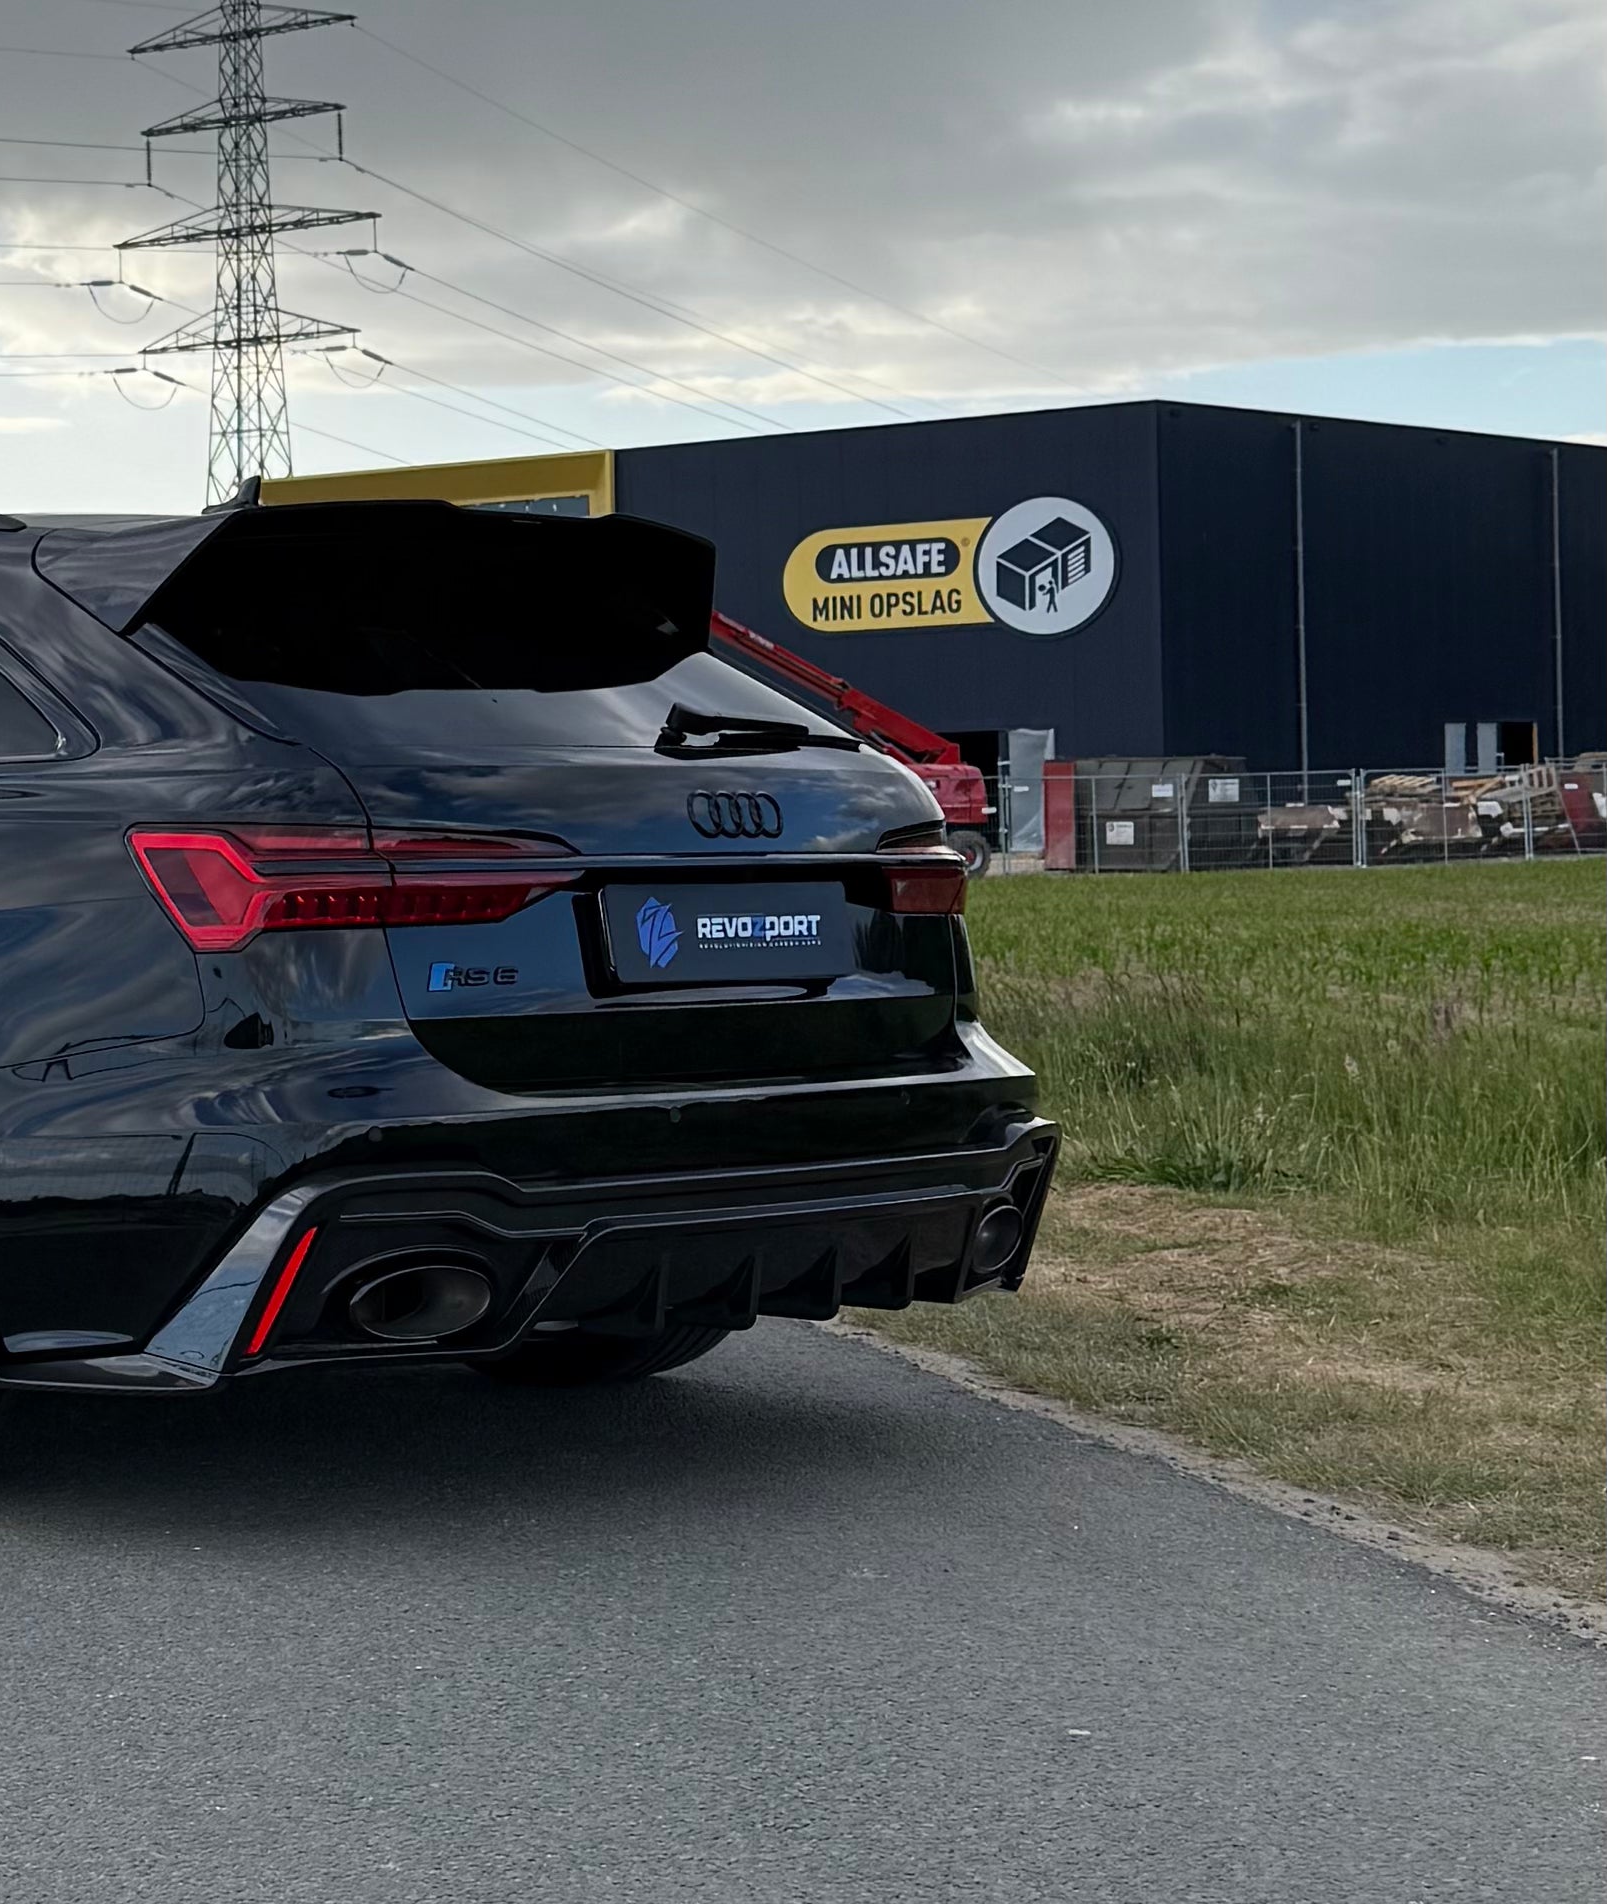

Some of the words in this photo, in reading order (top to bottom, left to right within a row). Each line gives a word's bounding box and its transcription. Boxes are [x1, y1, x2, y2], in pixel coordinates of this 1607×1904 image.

[830, 542, 946, 579] ALLSAFE
[812, 594, 862, 623] MINI
[869, 588, 962, 619] OPSLAG
